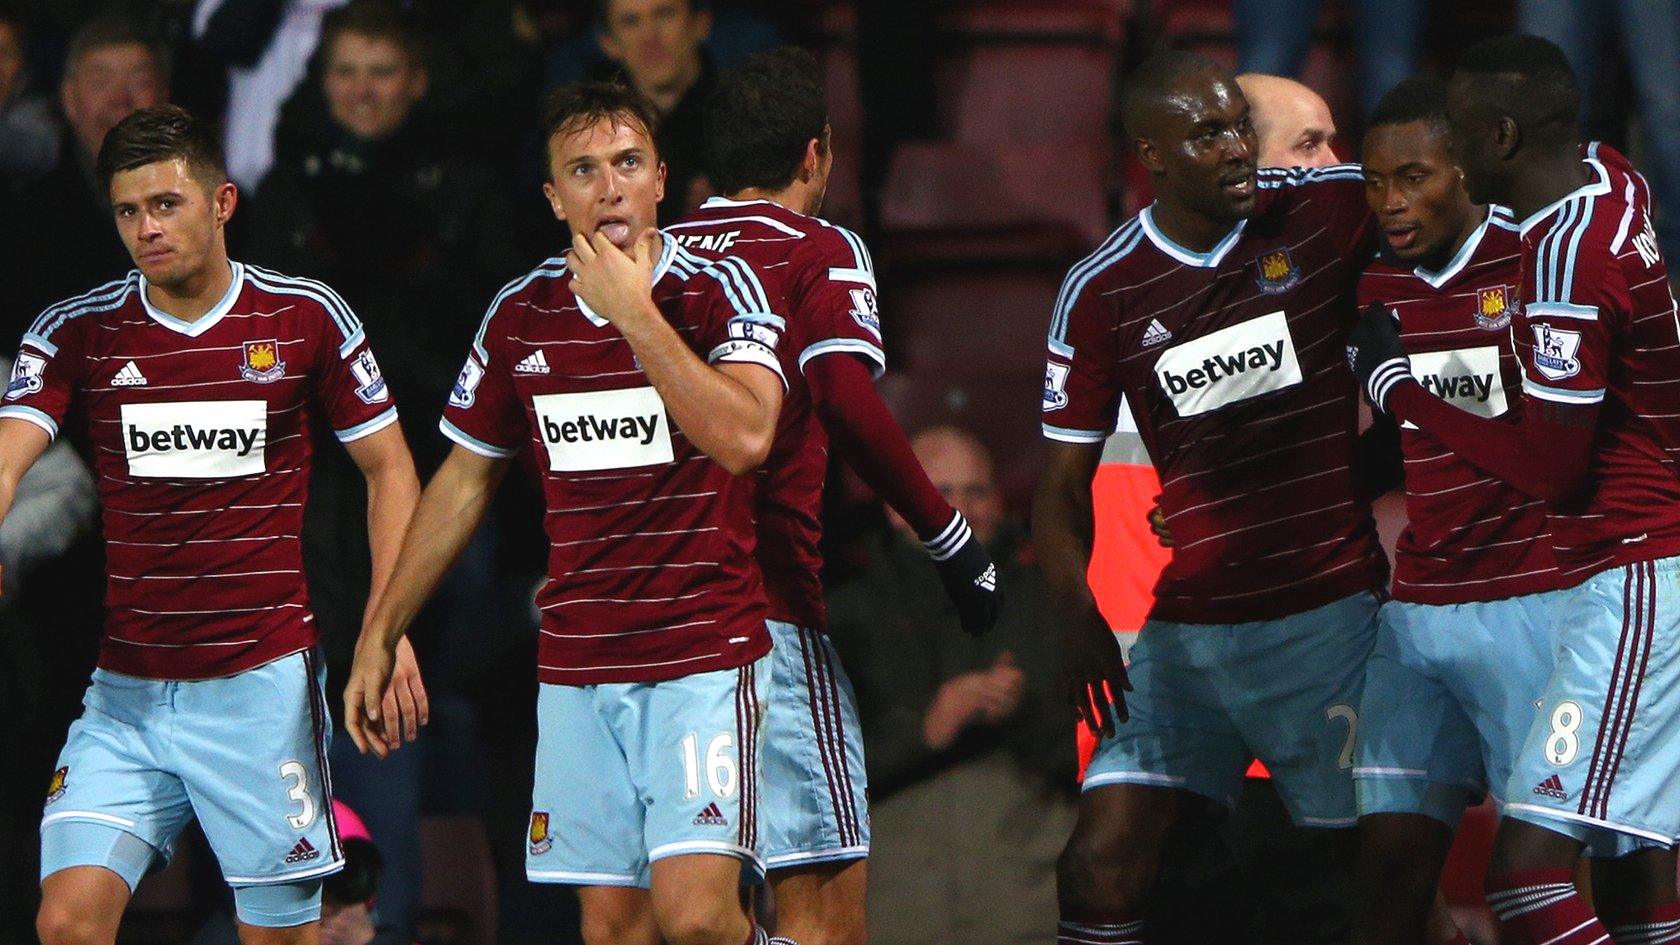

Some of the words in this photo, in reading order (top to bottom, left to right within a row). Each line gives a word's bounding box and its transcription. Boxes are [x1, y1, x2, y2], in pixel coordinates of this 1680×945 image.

[1142, 331, 1172, 346] adidas
[111, 376, 147, 386] adidas
[515, 363, 550, 374] adidas
[1163, 339, 1285, 395] betway
[1421, 374, 1494, 402] tway
[129, 424, 260, 457] betway
[543, 414, 659, 446] betway
[1544, 700, 1583, 768] 8
[681, 731, 737, 800] 16
[279, 760, 315, 830] 3
[1533, 786, 1568, 800] adidas
[285, 849, 320, 864] adidas
